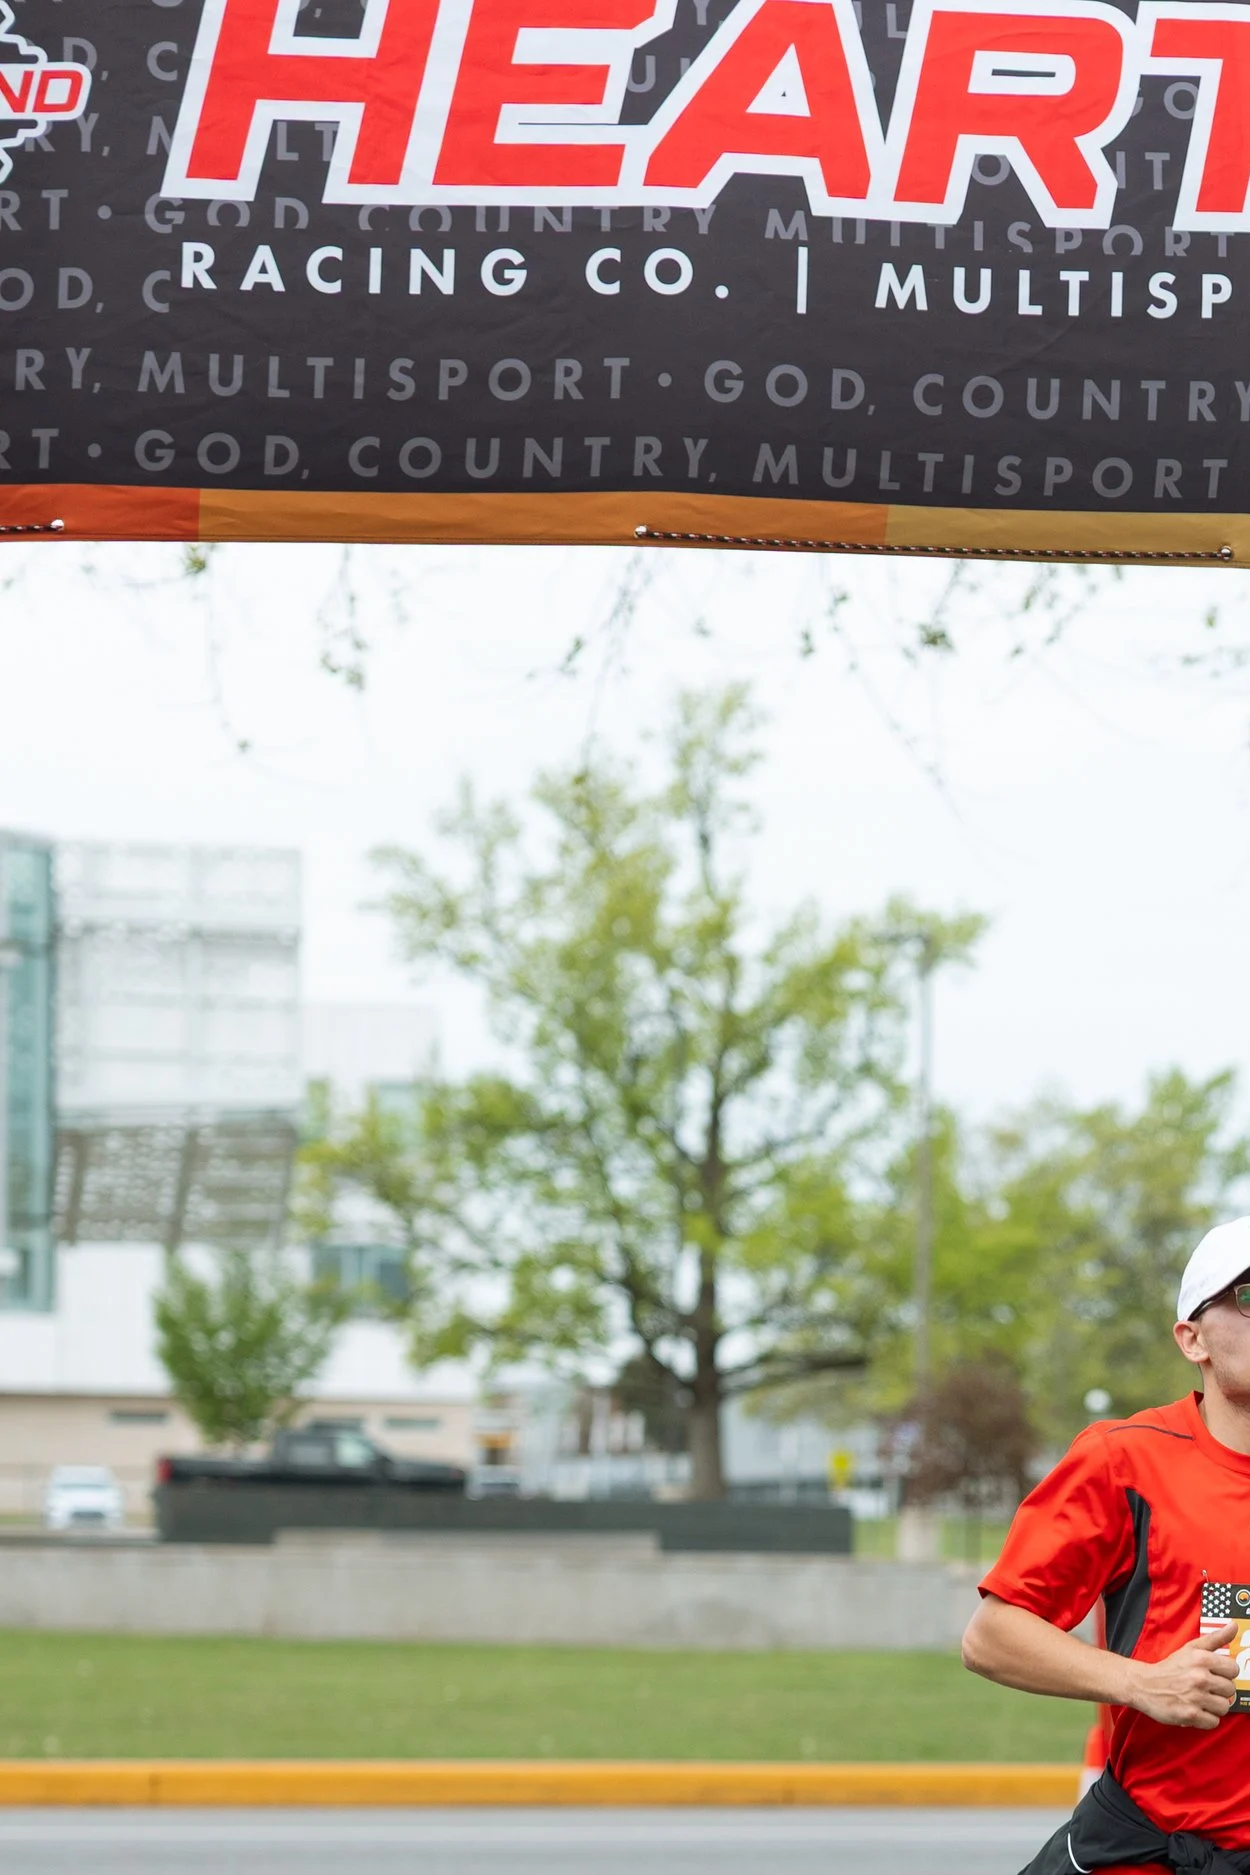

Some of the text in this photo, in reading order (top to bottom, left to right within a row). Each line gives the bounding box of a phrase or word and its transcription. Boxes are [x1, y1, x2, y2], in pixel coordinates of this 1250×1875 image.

[181, 241, 528, 296] RACING
[585, 247, 730, 300] CO.
[137, 350, 631, 401] MULTISPORT
[704, 360, 876, 416] GOD,
[134, 429, 310, 480] GOD,
[348, 435, 717, 483] COUNTRY,
[752, 443, 1228, 498] MULTISPORT
